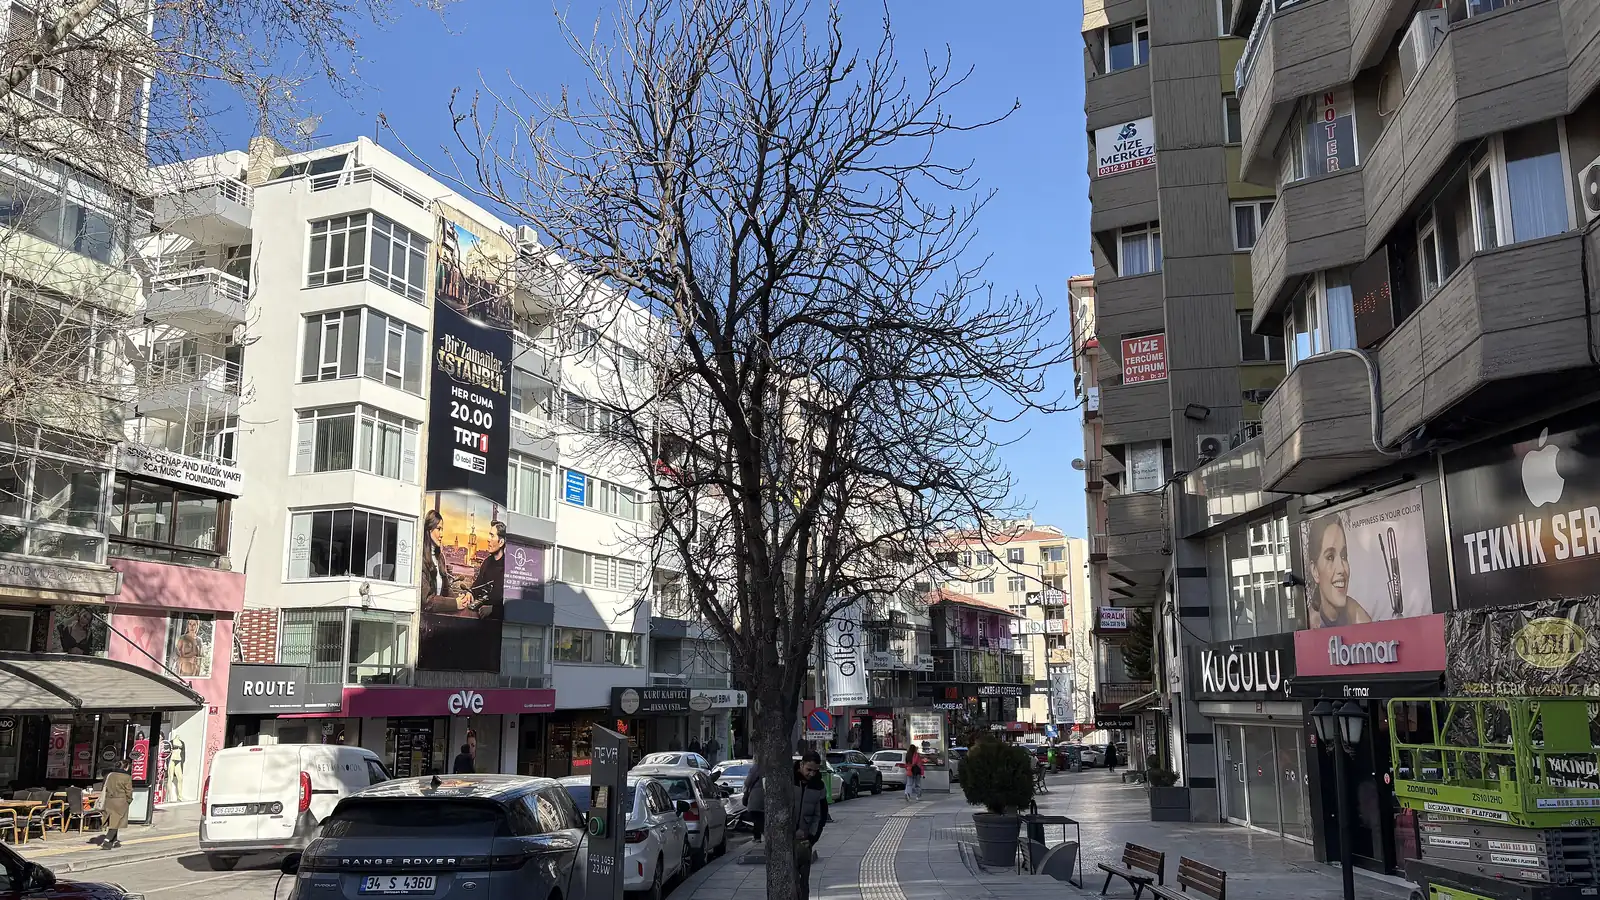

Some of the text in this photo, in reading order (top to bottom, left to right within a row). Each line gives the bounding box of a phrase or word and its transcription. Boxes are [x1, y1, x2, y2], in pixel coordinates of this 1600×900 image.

[1323, 91, 1340, 173] NOTER
[1113, 138, 1143, 152] VİZE
[1100, 165, 1119, 175] 0312
[1120, 161, 1133, 170] 911
[1135, 158, 1145, 167] 51
[444, 334, 503, 373] Bir Zamanlar
[1125, 352, 1164, 365] TERCÜME
[1125, 362, 1165, 375] OTURUM
[451, 386, 494, 410] HER CUMA
[450, 401, 493, 429] 20.00
[143, 462, 226, 488] SCA MUSIC FOUNDATION
[182, 460, 199, 472] AND
[200, 463, 222, 478] MÜZİK
[223, 469, 242, 483] VAKFI
[1351, 503, 1421, 529] HAPPINESS IS YOUR COLOR
[1463, 513, 1547, 575] TEKNİK
[8, 566, 31, 577] AND
[1328, 635, 1399, 666] flormar
[1201, 645, 1281, 693] KUĞULU
[242, 681, 295, 696] ROUTE
[643, 688, 688, 700] KURU KAHVECİ
[1000, 686, 1016, 695] COFFEE
[447, 690, 484, 714] eve
[932, 702, 963, 710] MACKBEAR
[1406, 784, 1438, 796] ZOOMLION
[1471, 792, 1503, 805] ZS1012HD
[1471, 808, 1502, 820] PLATFORM
[366, 876, 433, 890] 34 S 4360
